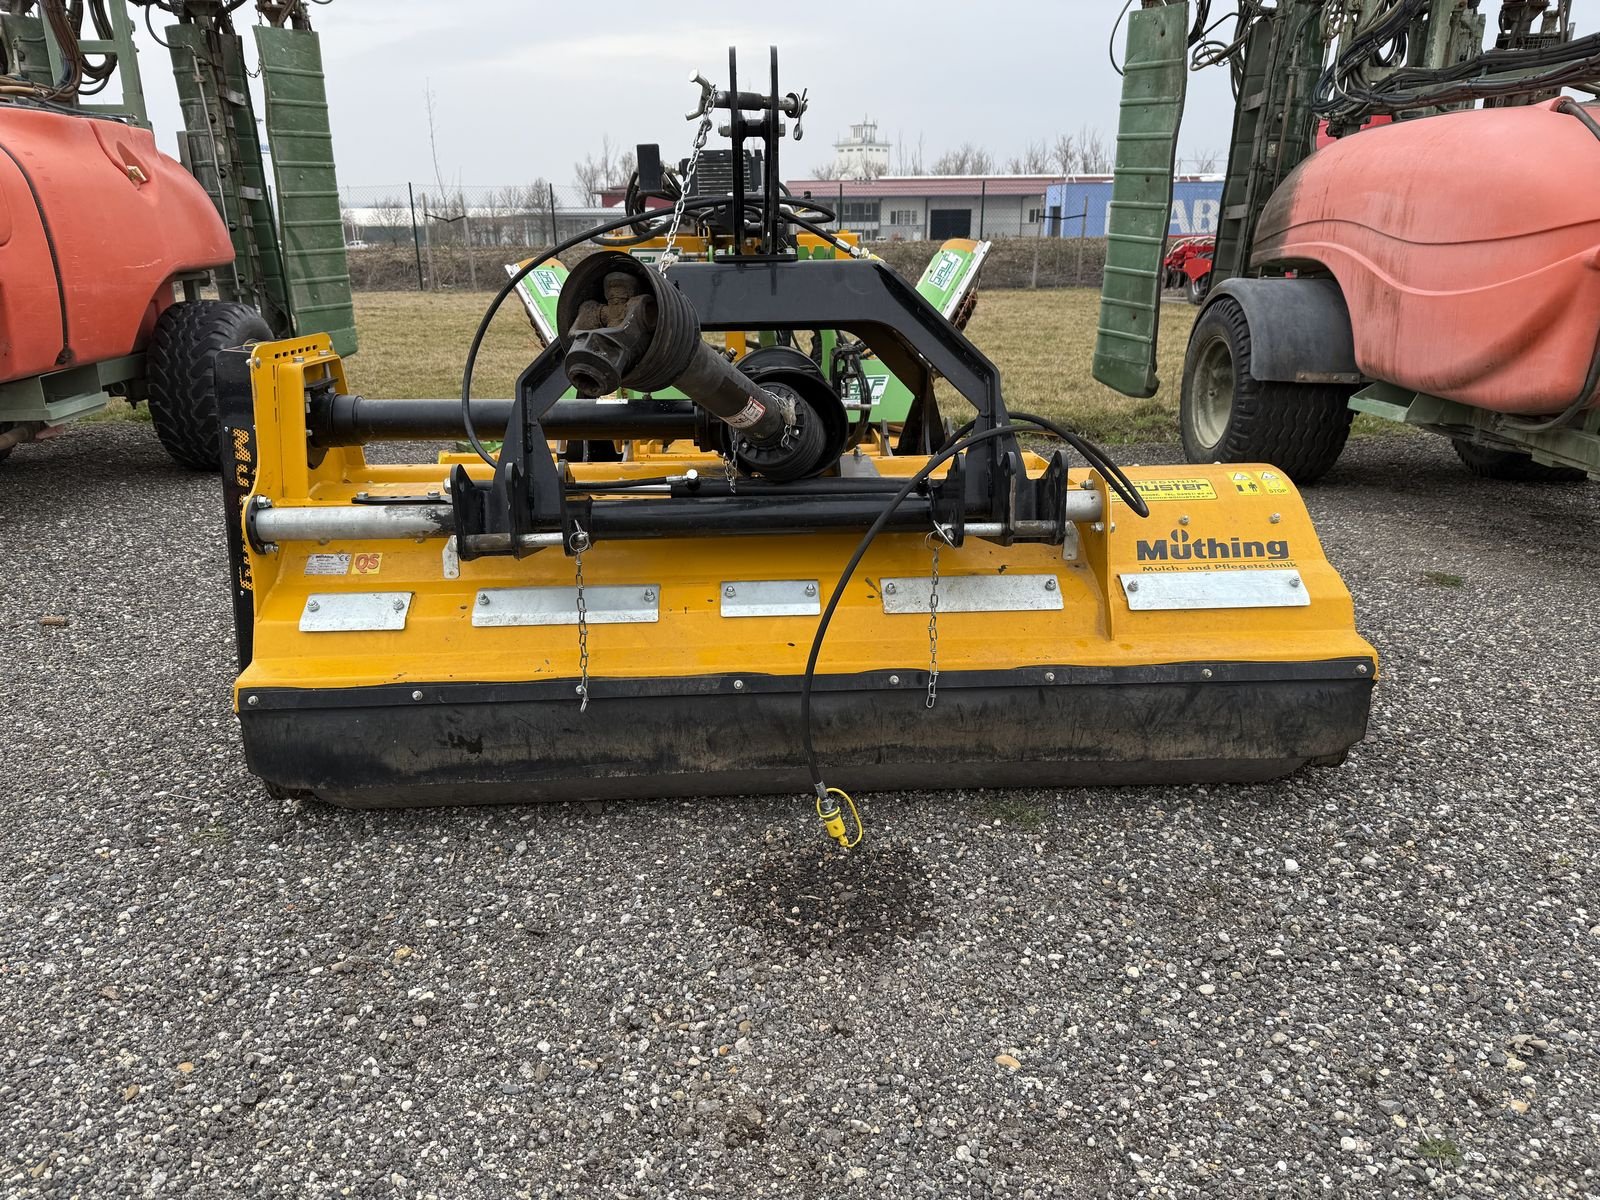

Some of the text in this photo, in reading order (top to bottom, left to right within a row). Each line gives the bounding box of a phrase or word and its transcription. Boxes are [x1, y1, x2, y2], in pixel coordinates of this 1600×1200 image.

[1137, 529, 1290, 560] Müthing
[355, 553, 380, 574] QS
[1215, 562, 1299, 571] Pflegetechnik
